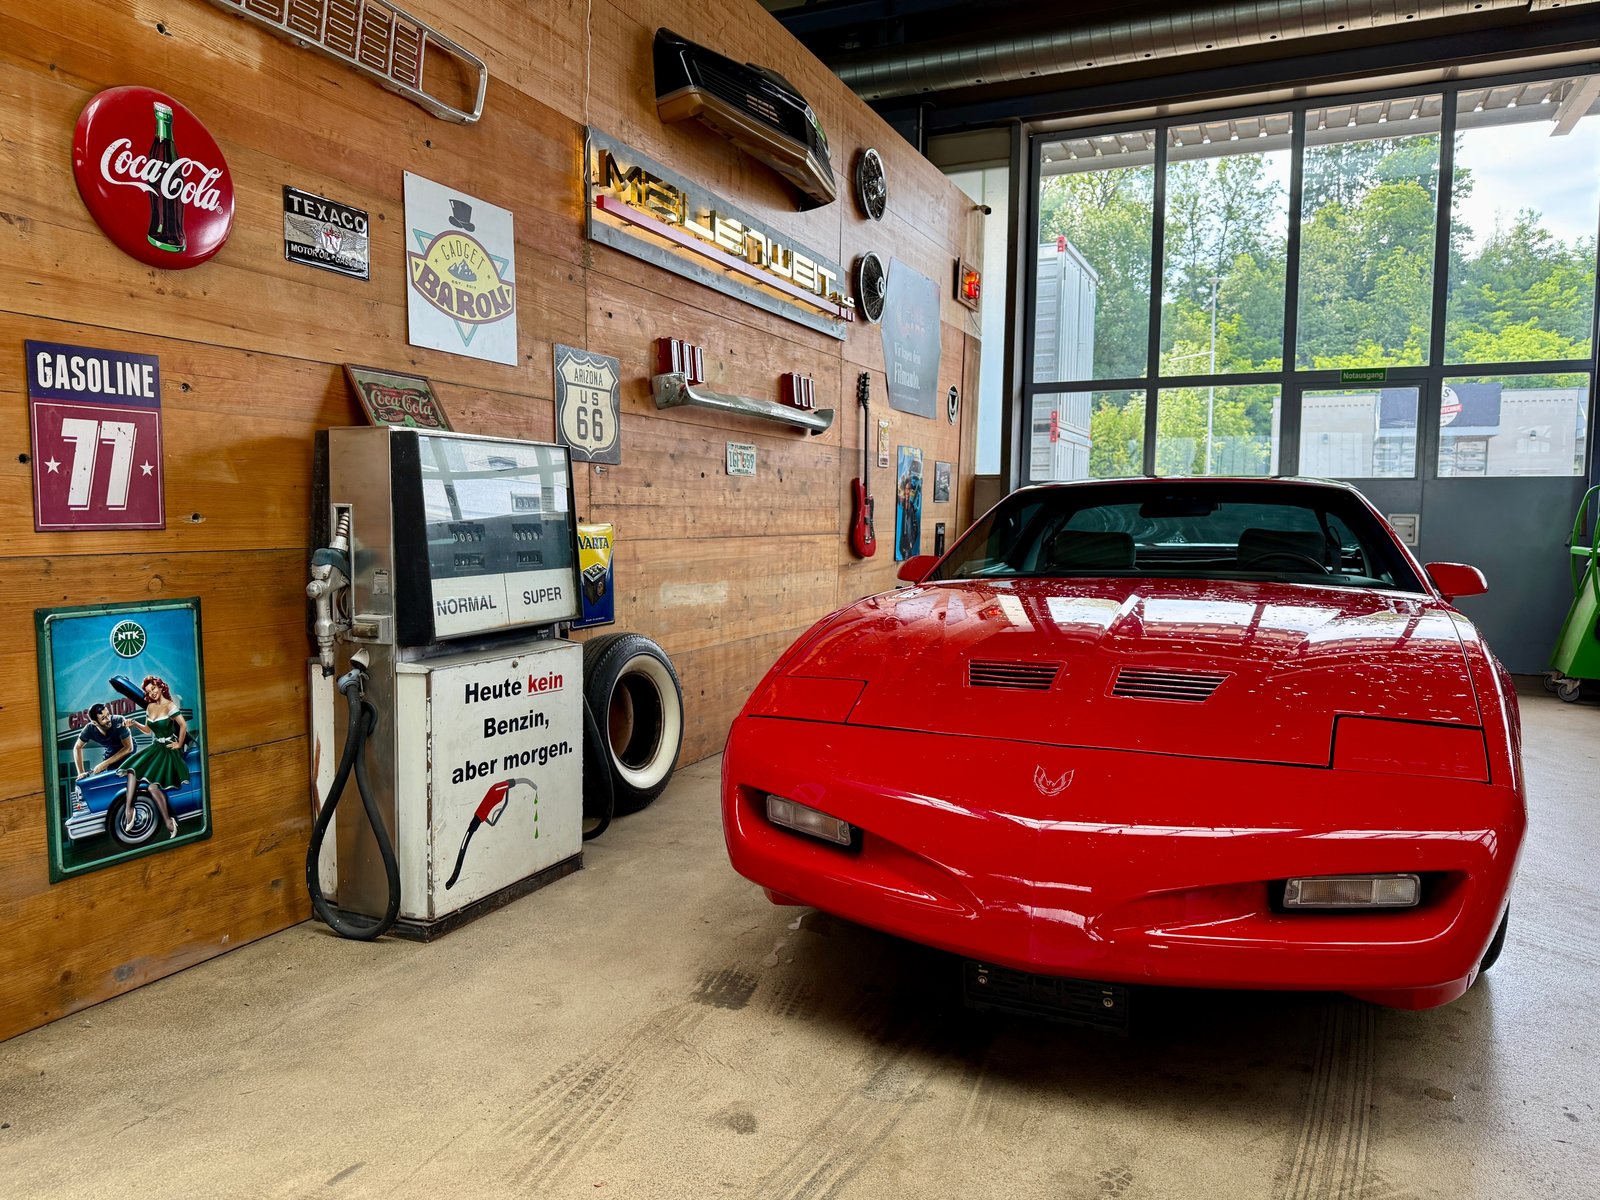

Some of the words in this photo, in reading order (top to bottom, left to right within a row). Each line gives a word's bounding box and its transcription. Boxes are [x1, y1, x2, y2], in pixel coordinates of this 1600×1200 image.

[100, 138, 223, 211] Coca-Cola
[288, 194, 366, 233] TEXACO
[290, 243, 318, 258] MOTOR
[318, 248, 331, 261] OIL
[440, 239, 486, 270] GADGET
[415, 262, 511, 318] BARON
[36, 351, 155, 398] GASOLINE
[574, 368, 603, 387] ARIZONA
[1343, 372, 1384, 380] Notausgang
[371, 389, 433, 416] Coca-Cola
[576, 405, 604, 442] 66
[577, 535, 609, 549] VARTA
[436, 595, 497, 616] NORMAL
[523, 587, 562, 605] SUPER
[118, 630, 140, 641] NTK
[464, 678, 523, 704] Heute
[527, 671, 563, 695] kein
[483, 709, 550, 739] Benzin,
[452, 758, 498, 785] aber
[503, 740, 573, 771] morgen.
